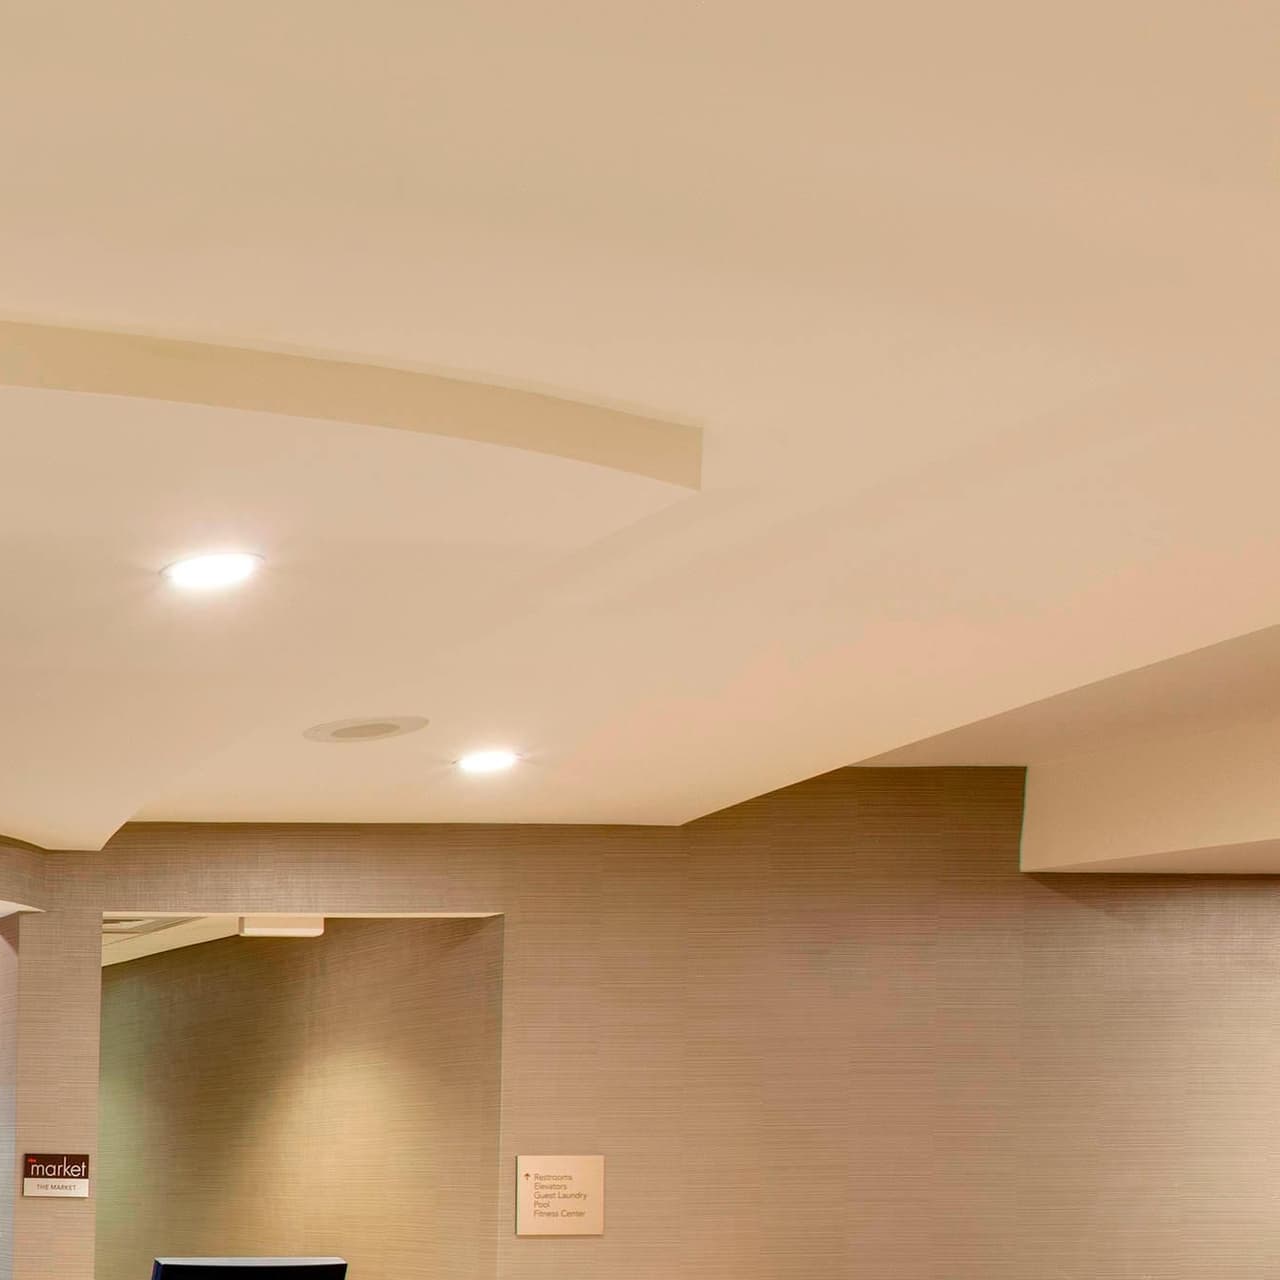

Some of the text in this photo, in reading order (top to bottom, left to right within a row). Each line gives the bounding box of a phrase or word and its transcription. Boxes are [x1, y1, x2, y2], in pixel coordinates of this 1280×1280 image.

[31, 1156, 86, 1176] market
[534, 1182, 568, 1190] Elevators
[558, 1192, 587, 1200] Laundry
[534, 1200, 550, 1208] Pool
